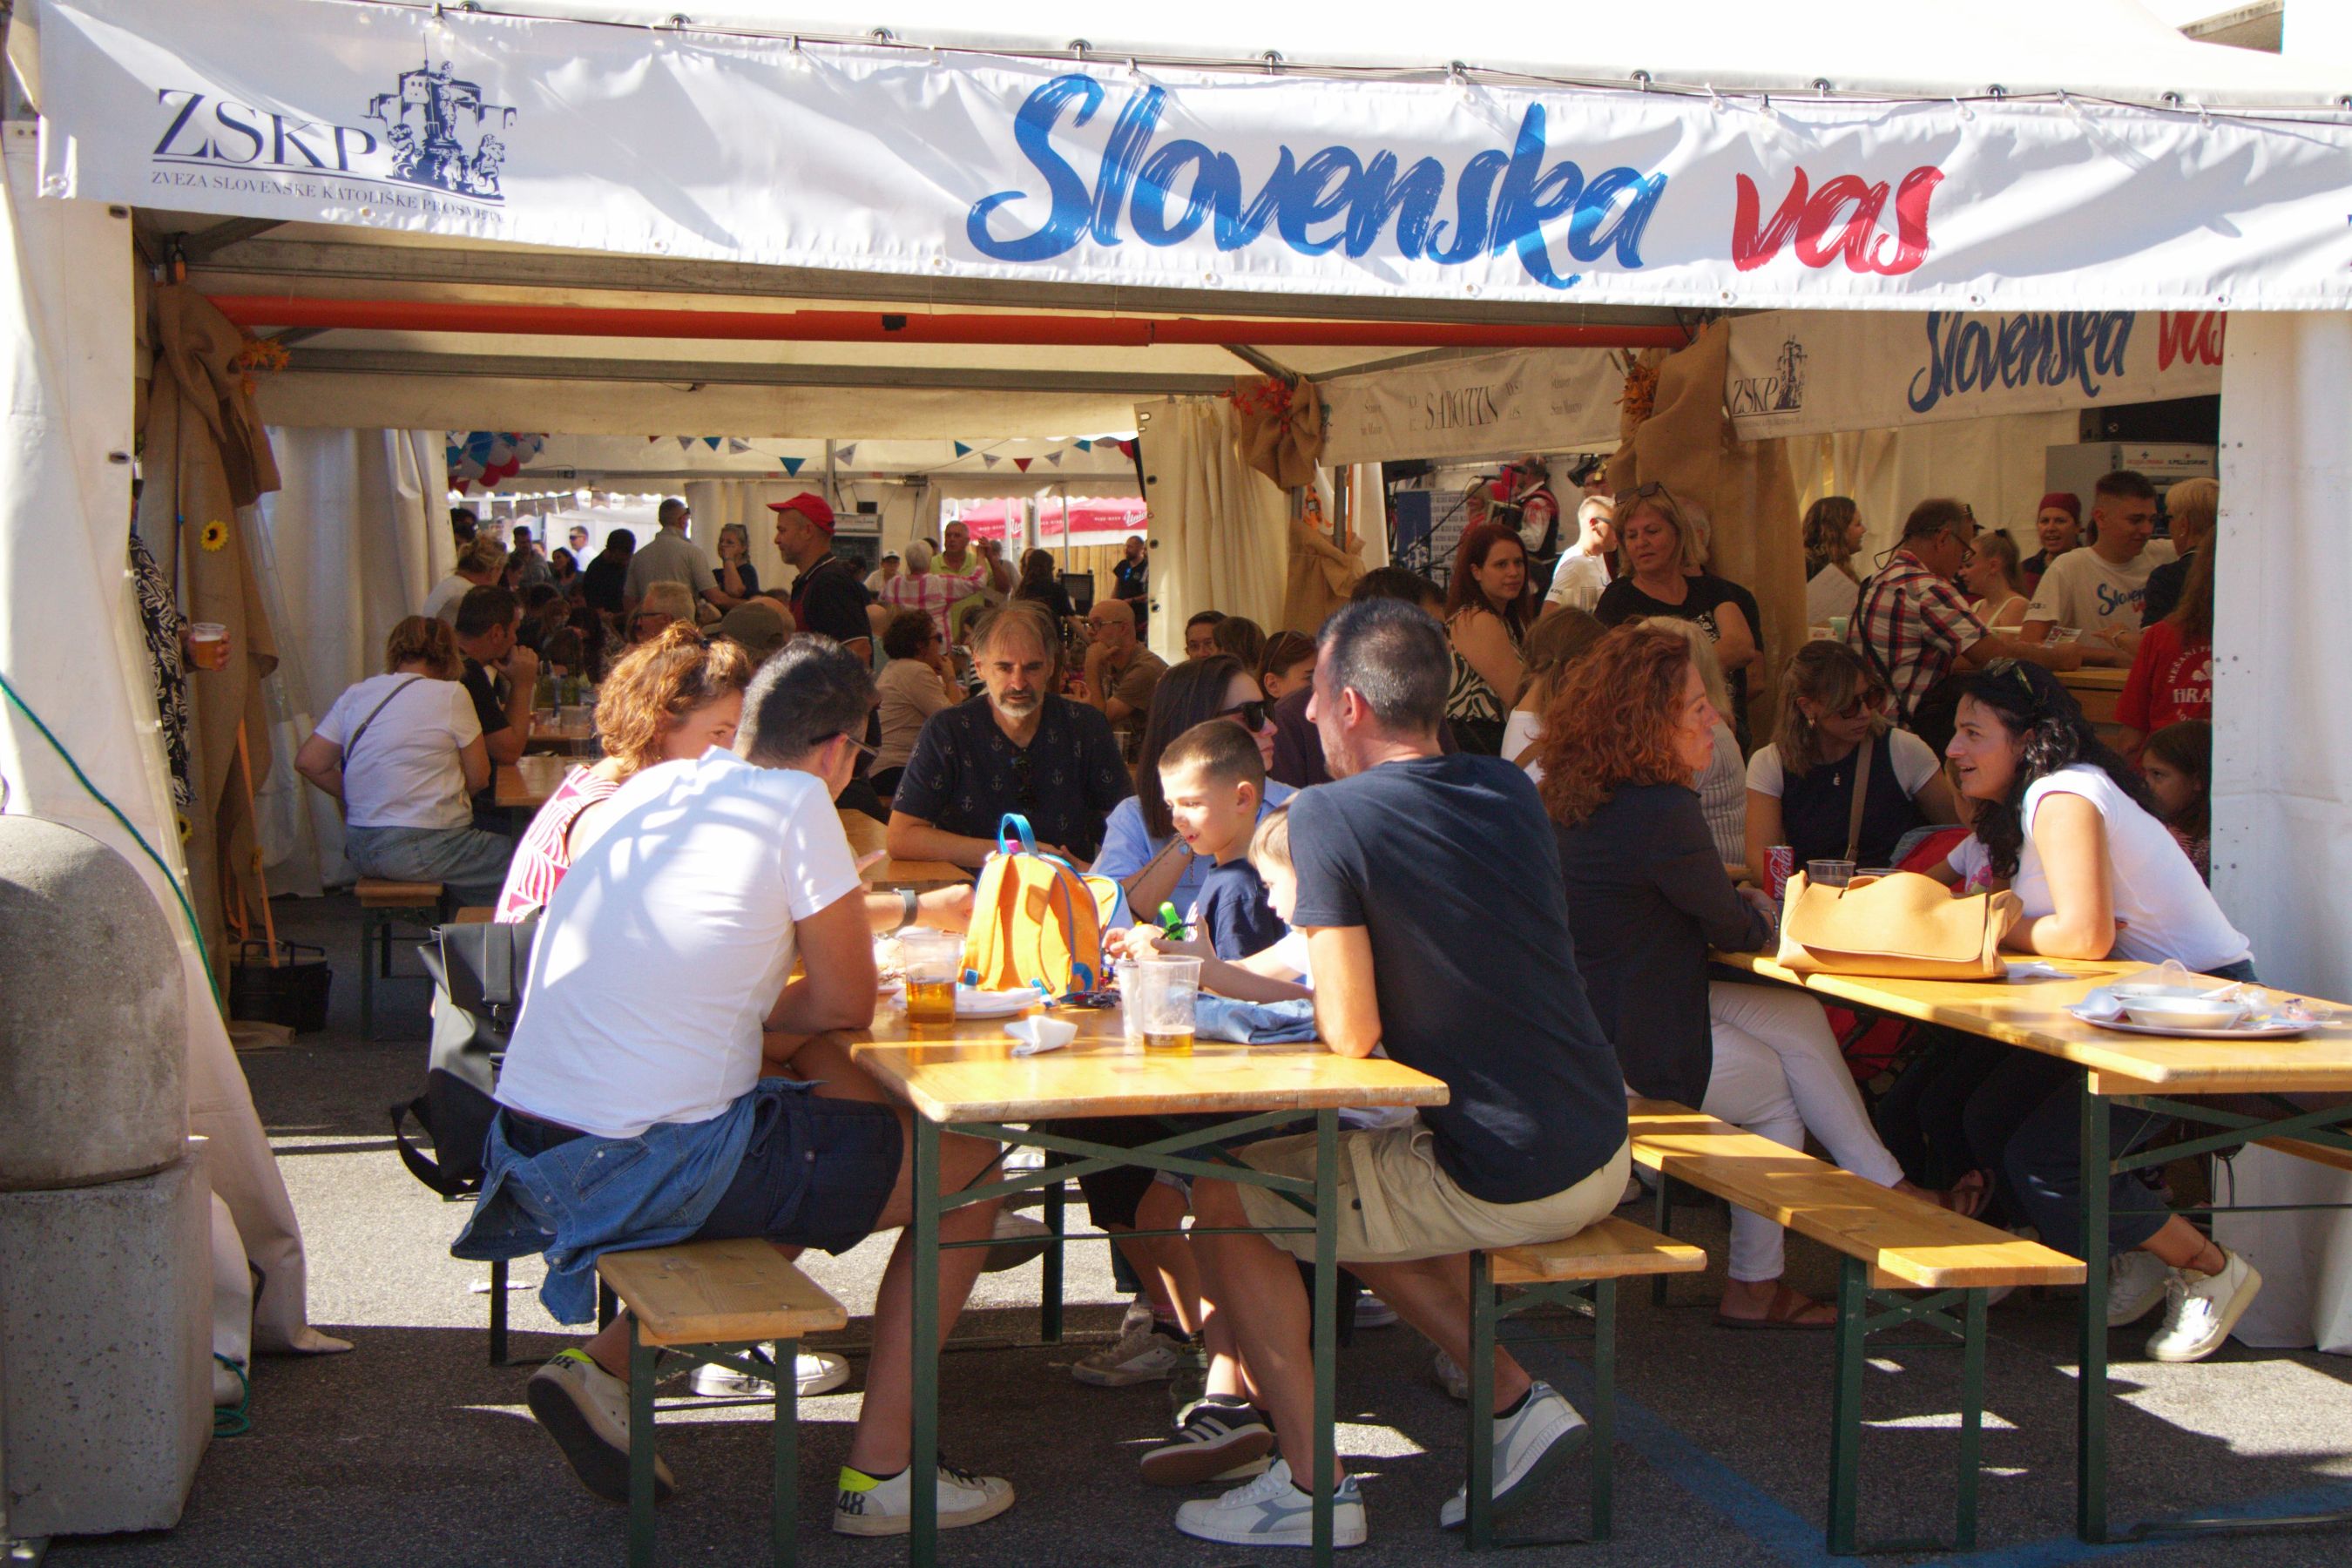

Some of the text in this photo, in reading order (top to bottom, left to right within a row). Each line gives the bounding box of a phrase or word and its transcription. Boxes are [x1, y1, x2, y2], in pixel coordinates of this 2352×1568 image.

[152, 88, 377, 173] ZSKP
[152, 172, 208, 189] ZVEZA
[213, 176, 316, 198] SLOVENSKE
[322, 186, 418, 210] KATOLIŠKE
[967, 73, 1944, 289] Slovenska vas
[838, 1490, 866, 1515] 48
